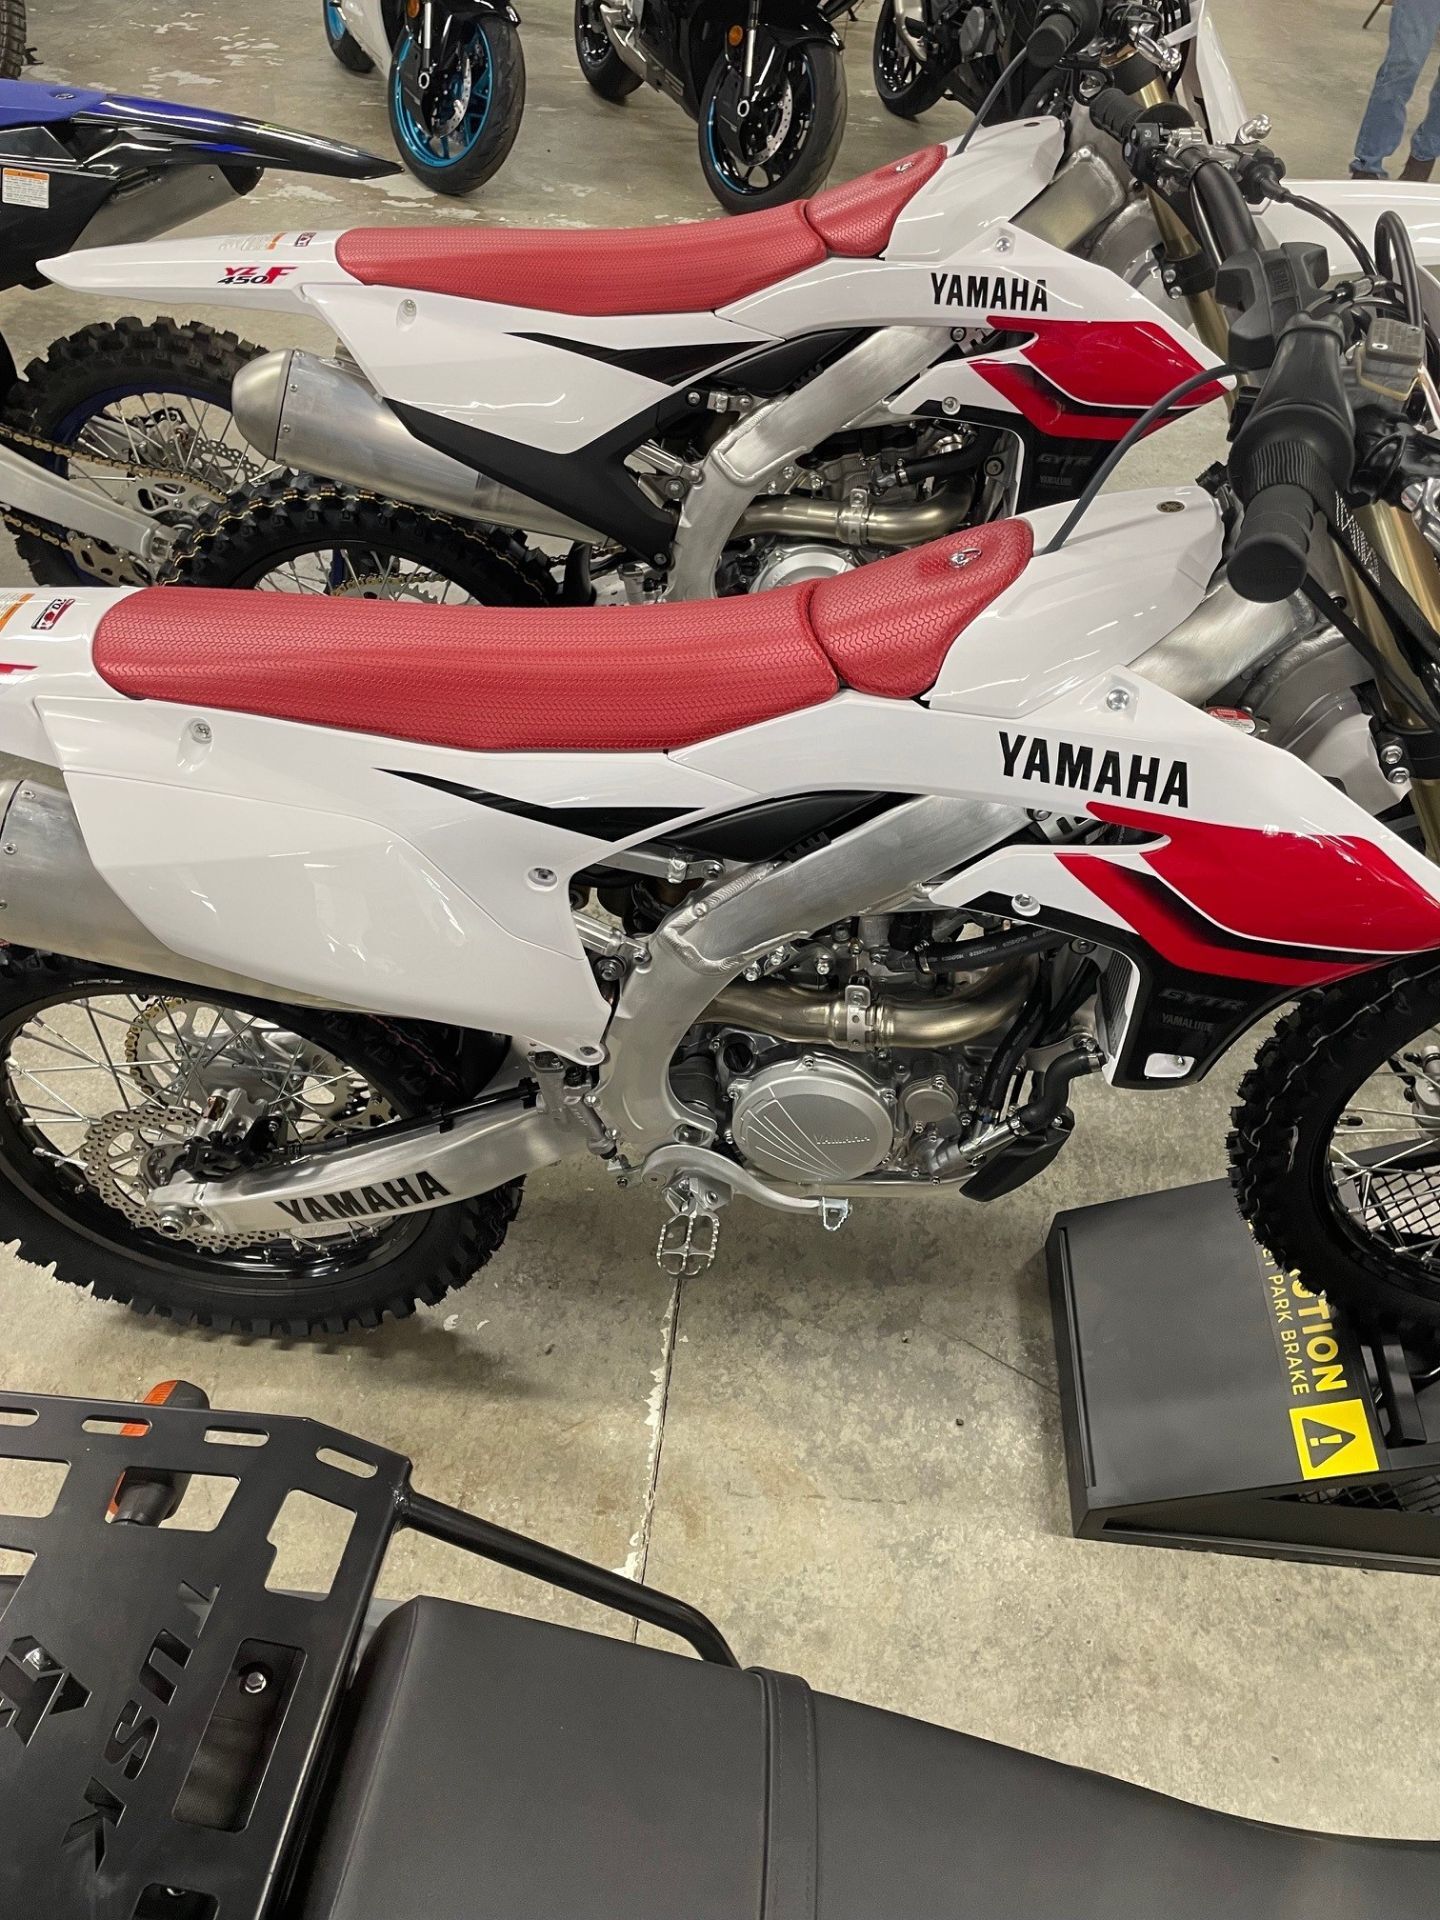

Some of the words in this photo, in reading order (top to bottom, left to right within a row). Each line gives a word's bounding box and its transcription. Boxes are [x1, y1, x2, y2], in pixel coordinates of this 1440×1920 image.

[224, 266, 261, 276] YZ
[930, 272, 1048, 312] YAMAHA
[998, 730, 1189, 809] YAMAHA
[273, 1170, 453, 1226] YAMAHA
[1267, 1274, 1294, 1324] PARK
[1280, 1328, 1311, 1396] BRAKE
[60, 1579, 222, 1875] TUSK
